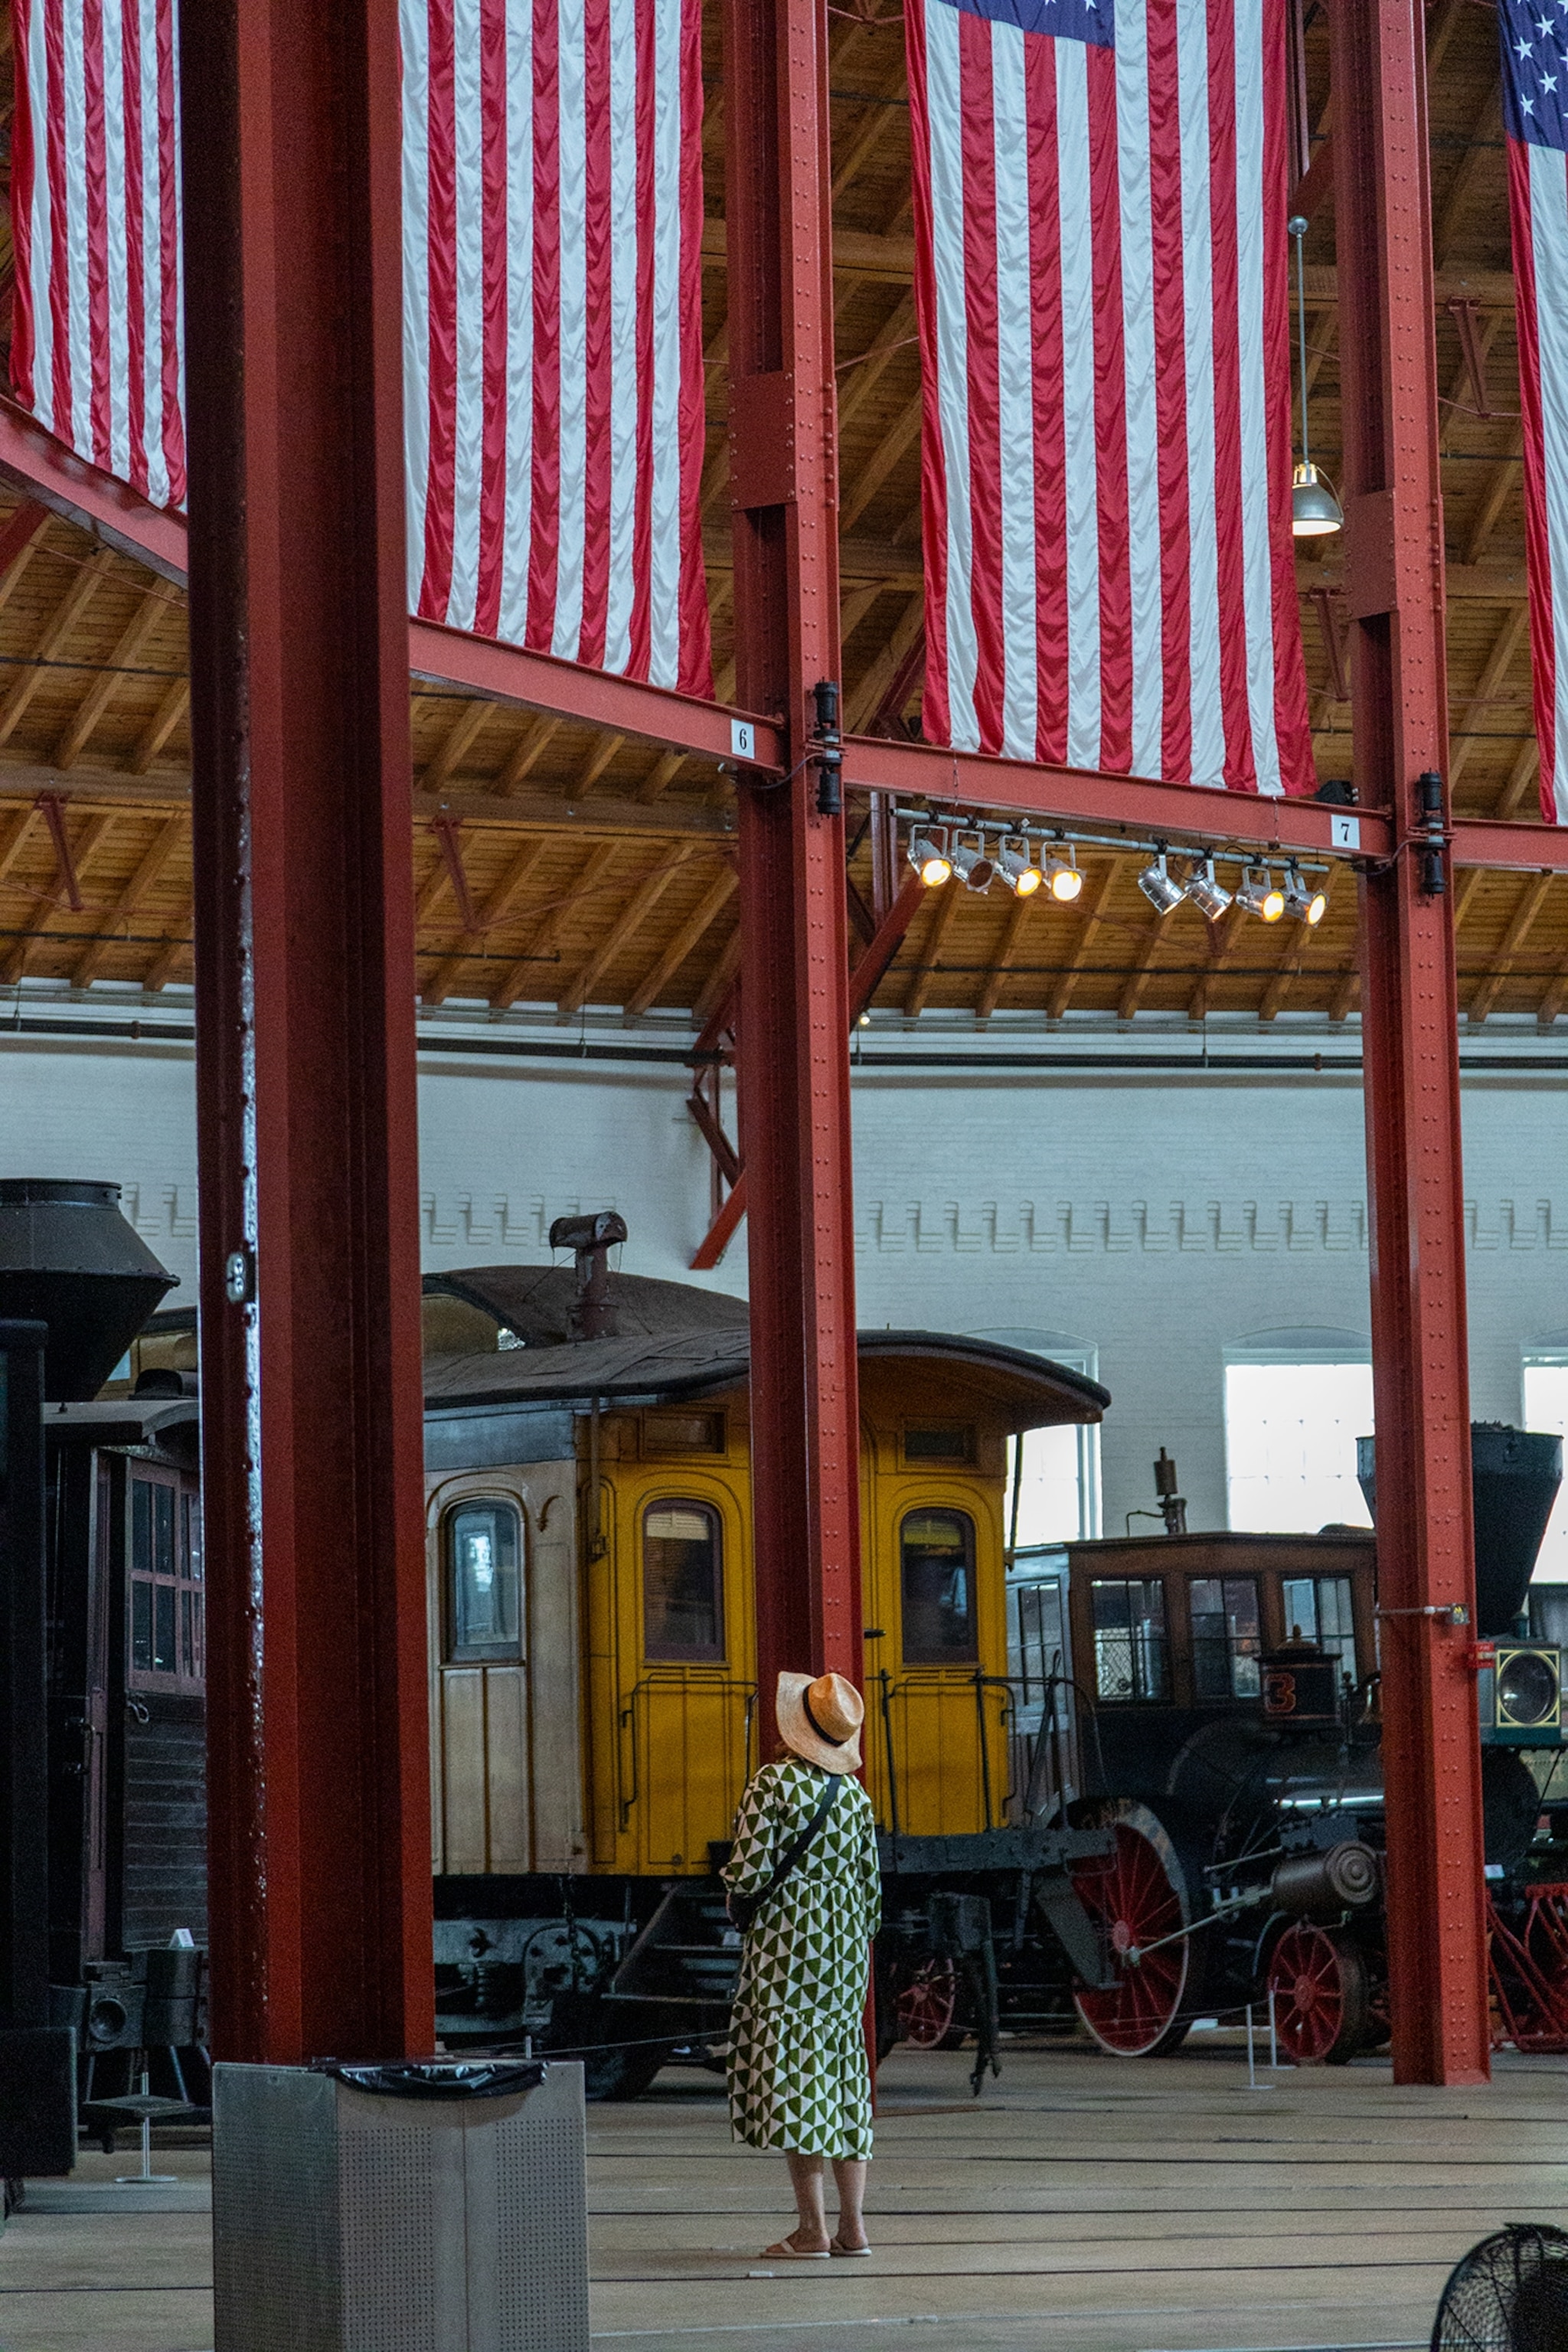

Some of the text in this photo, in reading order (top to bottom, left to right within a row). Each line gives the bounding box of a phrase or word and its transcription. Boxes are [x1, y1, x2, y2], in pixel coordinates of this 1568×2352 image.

[740, 728, 746, 750] 6
[1341, 823, 1349, 841] 7
[1265, 1673, 1296, 1713] 3
